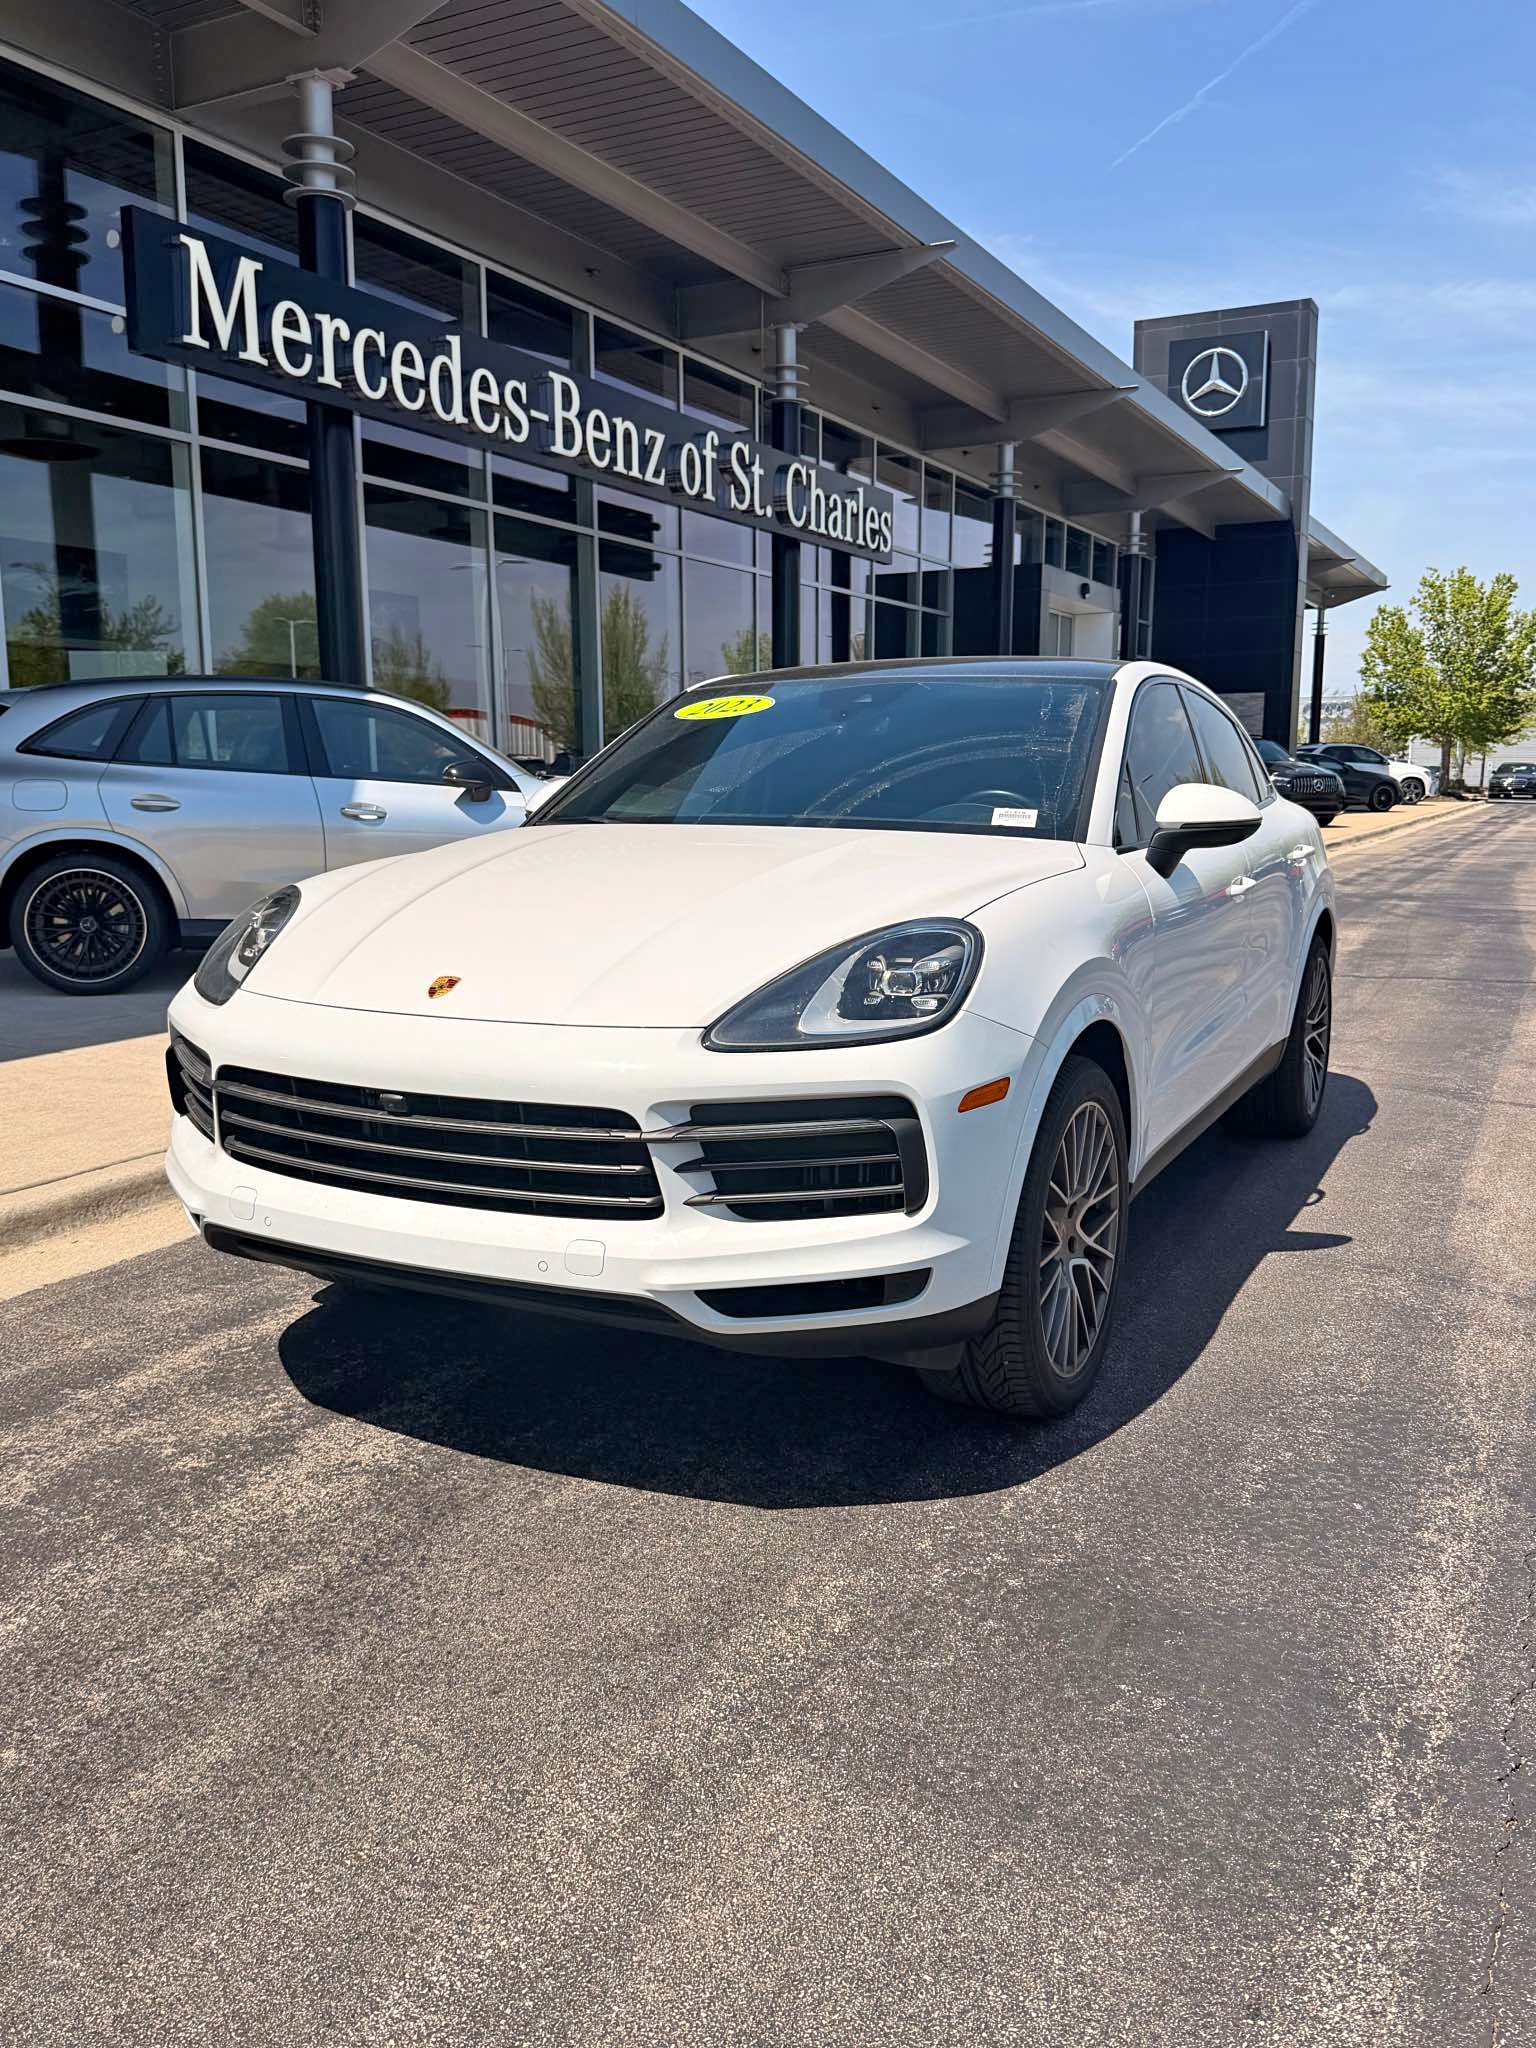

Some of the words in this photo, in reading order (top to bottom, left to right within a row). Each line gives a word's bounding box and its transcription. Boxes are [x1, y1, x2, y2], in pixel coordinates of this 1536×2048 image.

[179, 233, 666, 487] Mercedes-Benz
[680, 430, 719, 502] of
[730, 441, 773, 518] St.
[786, 462, 893, 553] Charles
[686, 699, 762, 716] 2023
